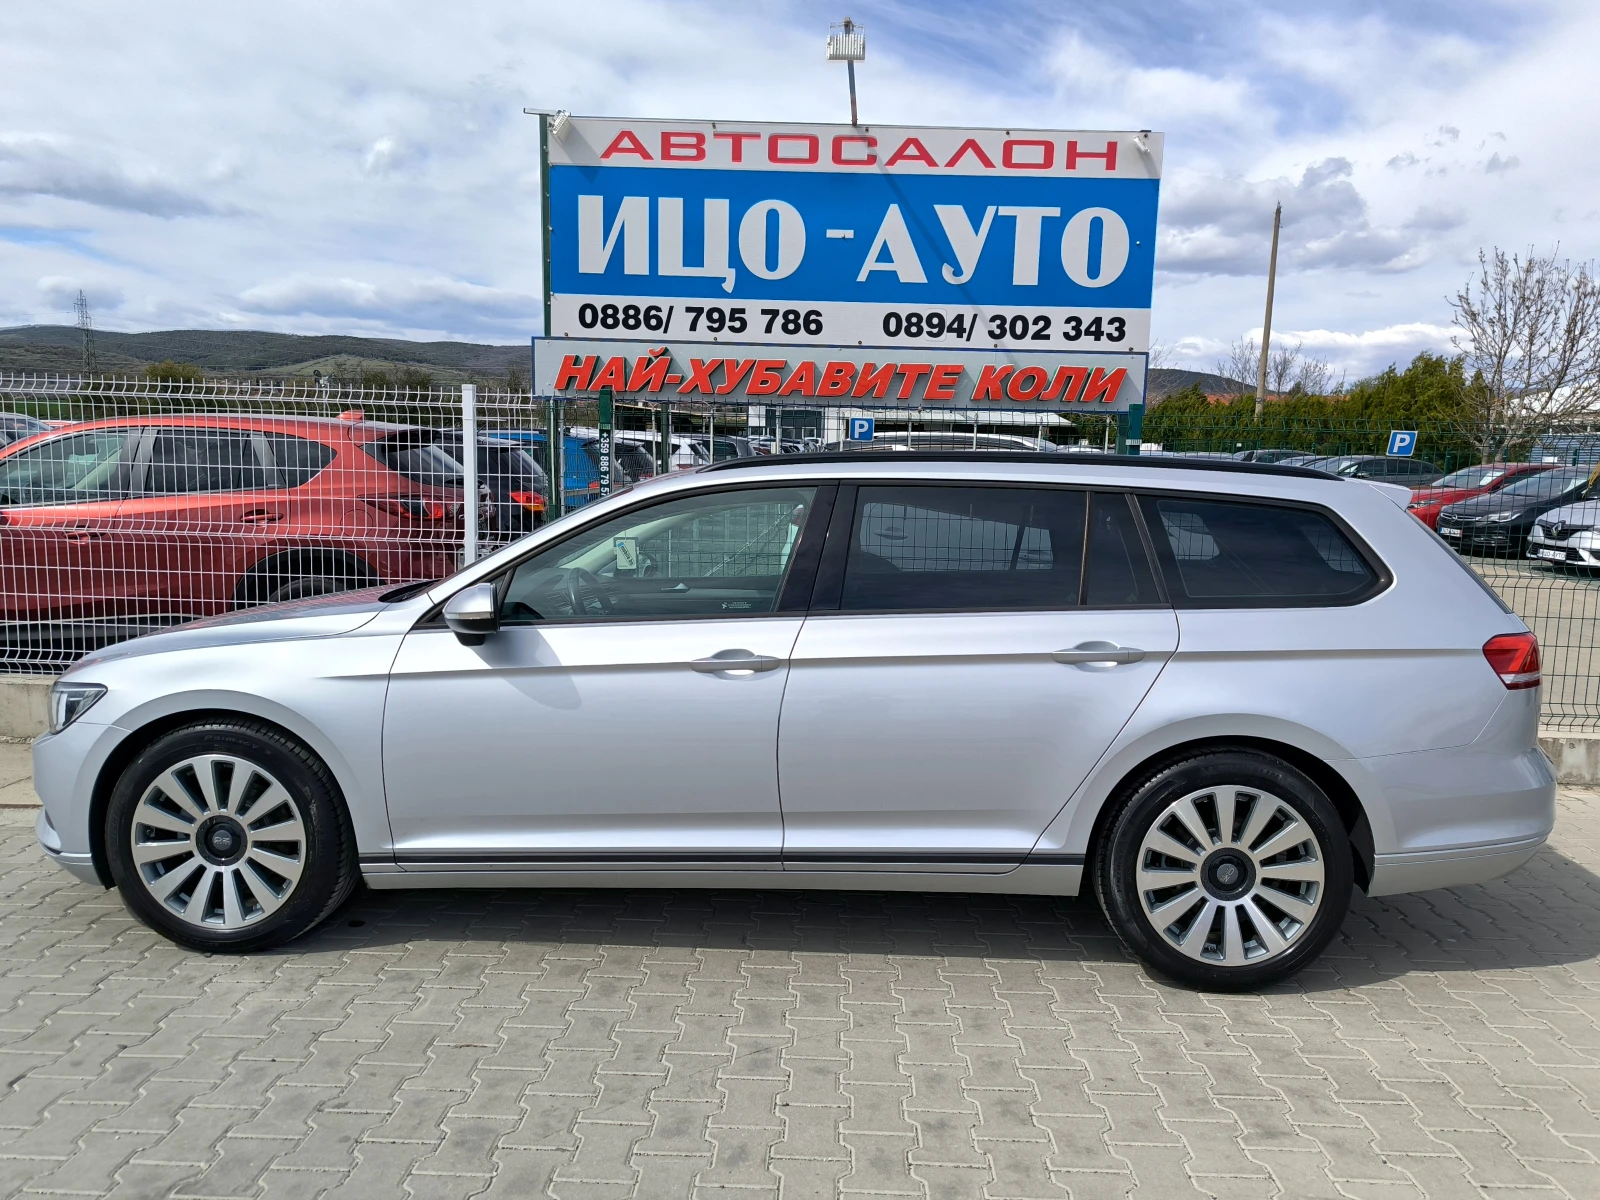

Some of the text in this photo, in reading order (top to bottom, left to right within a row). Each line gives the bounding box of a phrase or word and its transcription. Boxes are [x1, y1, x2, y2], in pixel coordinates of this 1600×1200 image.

[599, 130, 1118, 171] АВТОСАЛОН
[577, 194, 806, 293] ИЦО
[578, 303, 824, 335] 0886/ 795 786
[882, 312, 1127, 342] 0894/ 302 343
[553, 346, 1128, 403] НАЙ-ХУБАВИТЕ КОЛИ
[854, 420, 869, 439] P
[600, 432, 610, 454] +359
[1392, 433, 1411, 453] P
[600, 455, 610, 472] 886
[600, 473, 610, 485] 79
